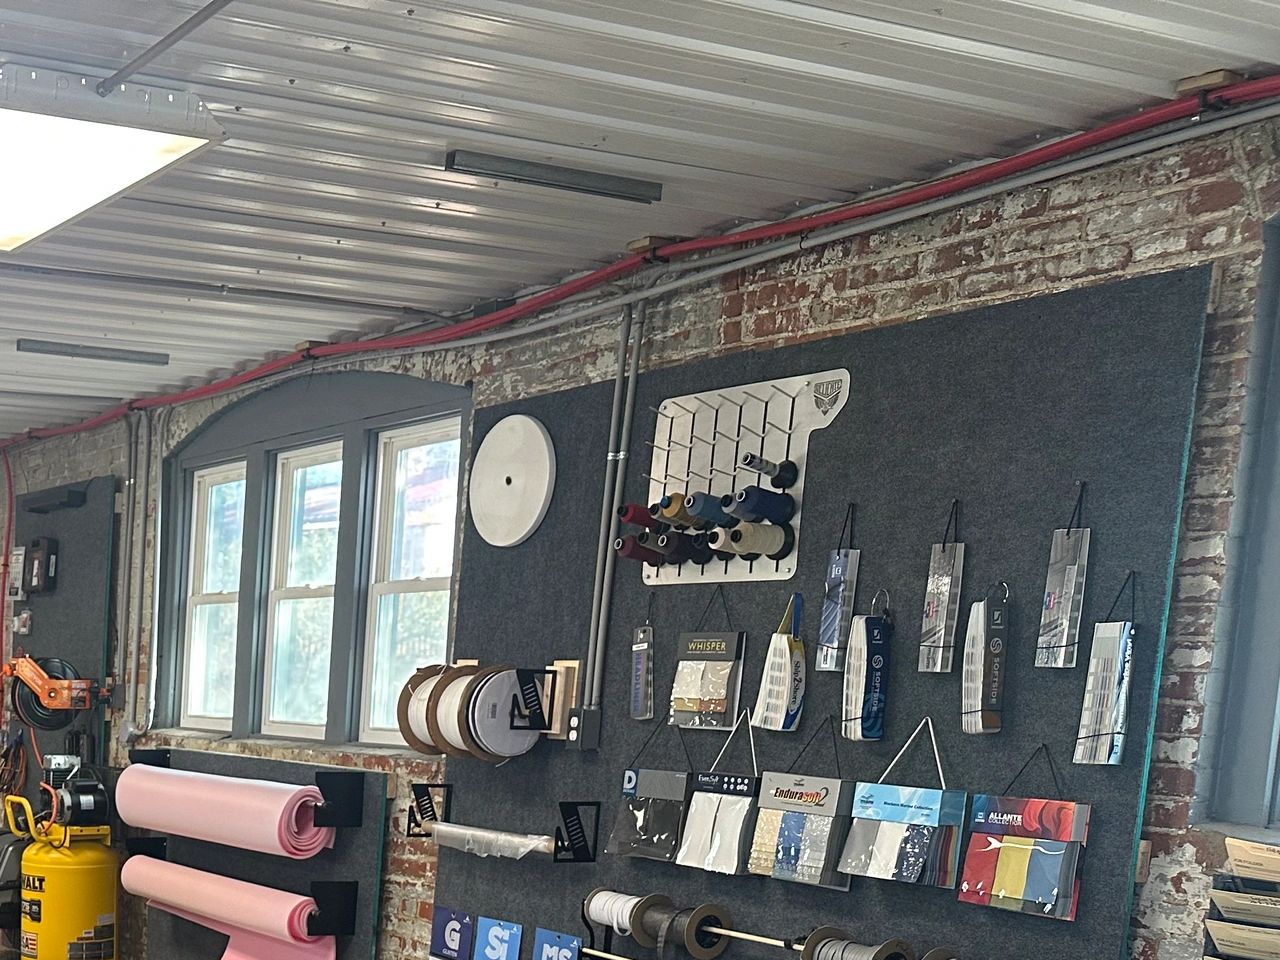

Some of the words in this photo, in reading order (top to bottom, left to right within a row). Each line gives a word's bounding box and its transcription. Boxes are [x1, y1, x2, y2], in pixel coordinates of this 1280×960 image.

[688, 641, 726, 650] WHISPER
[990, 657, 1000, 704] SOFTSIDE
[872, 671, 881, 712] SOFTSIDE
[988, 811, 1023, 821] ALLANTE
[988, 818, 1022, 826] COLLECTION
[444, 920, 461, 951] G
